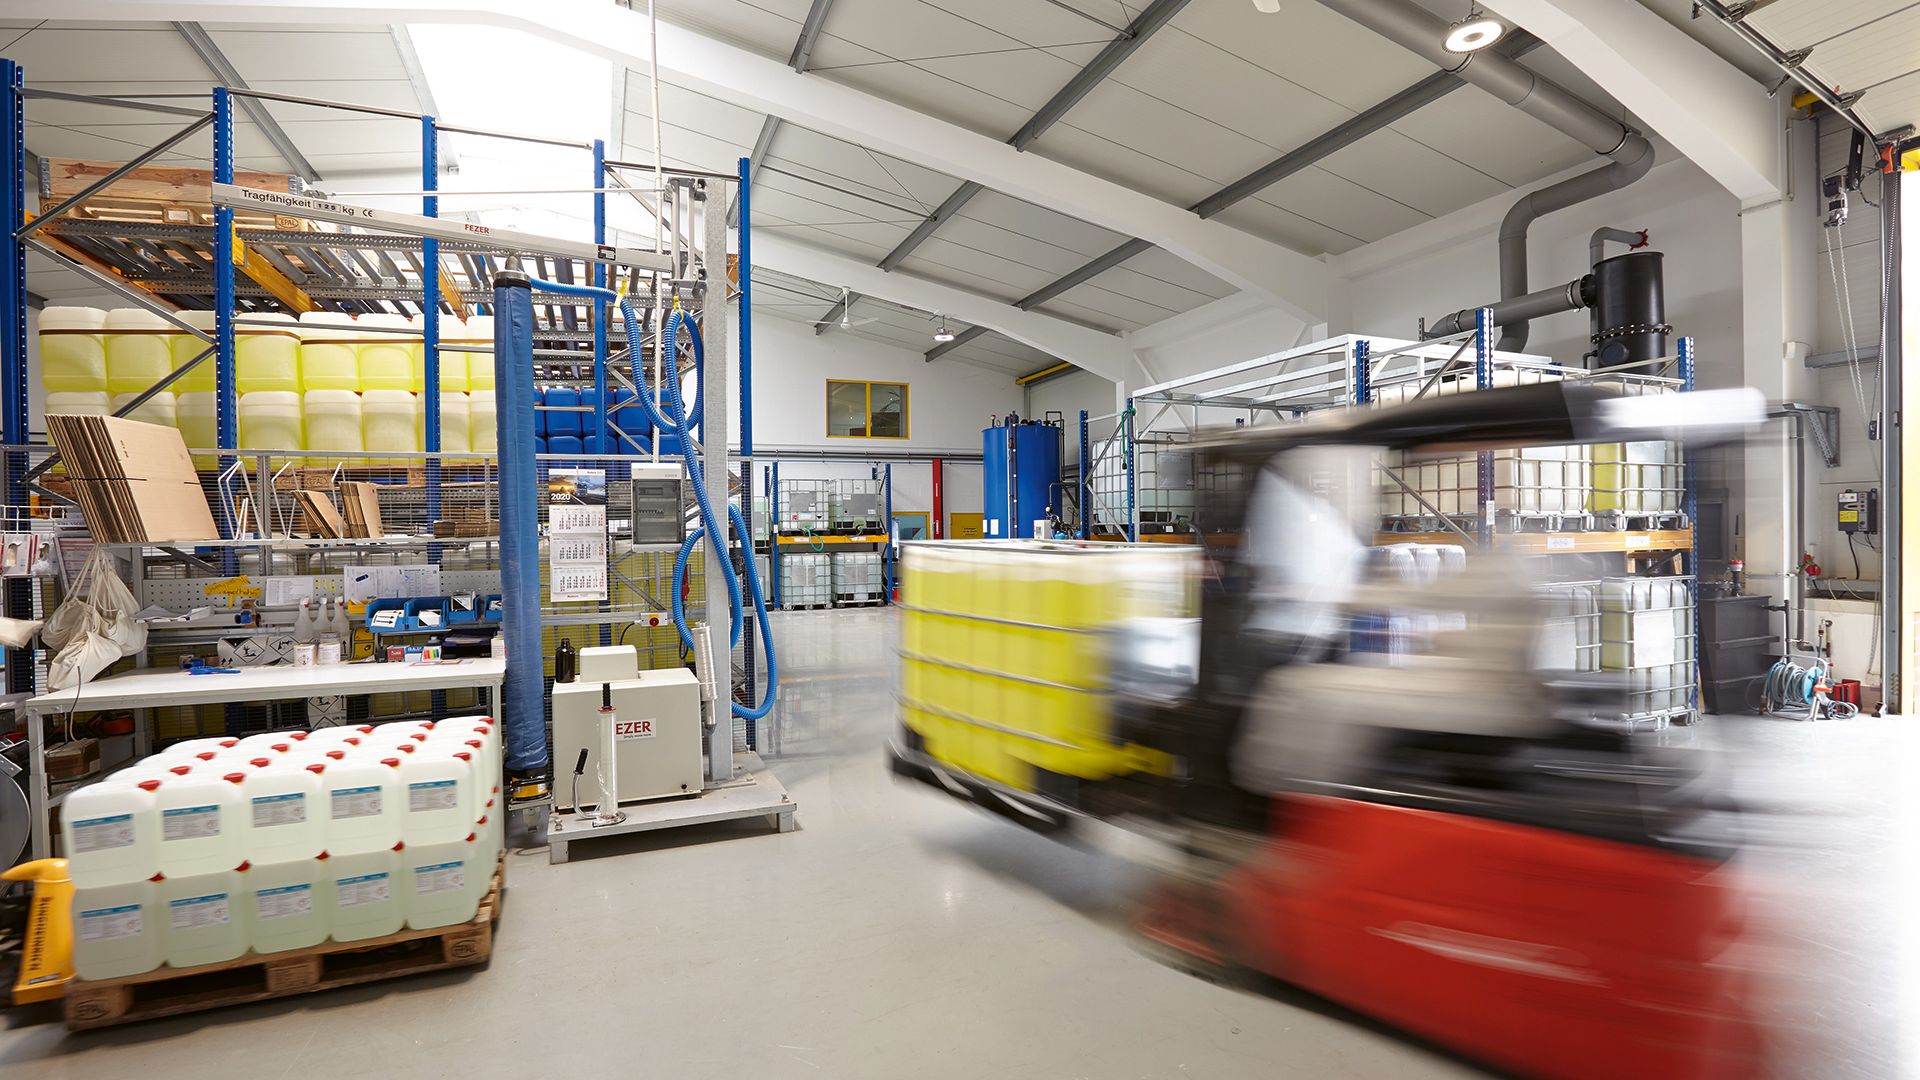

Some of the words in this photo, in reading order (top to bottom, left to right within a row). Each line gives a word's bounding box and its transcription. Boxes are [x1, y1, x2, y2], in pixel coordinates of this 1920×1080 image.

[242, 189, 311, 208] Tragfähigkeit
[342, 206, 355, 216] kg
[464, 223, 489, 234] FEZER
[615, 721, 652, 734] EZER
